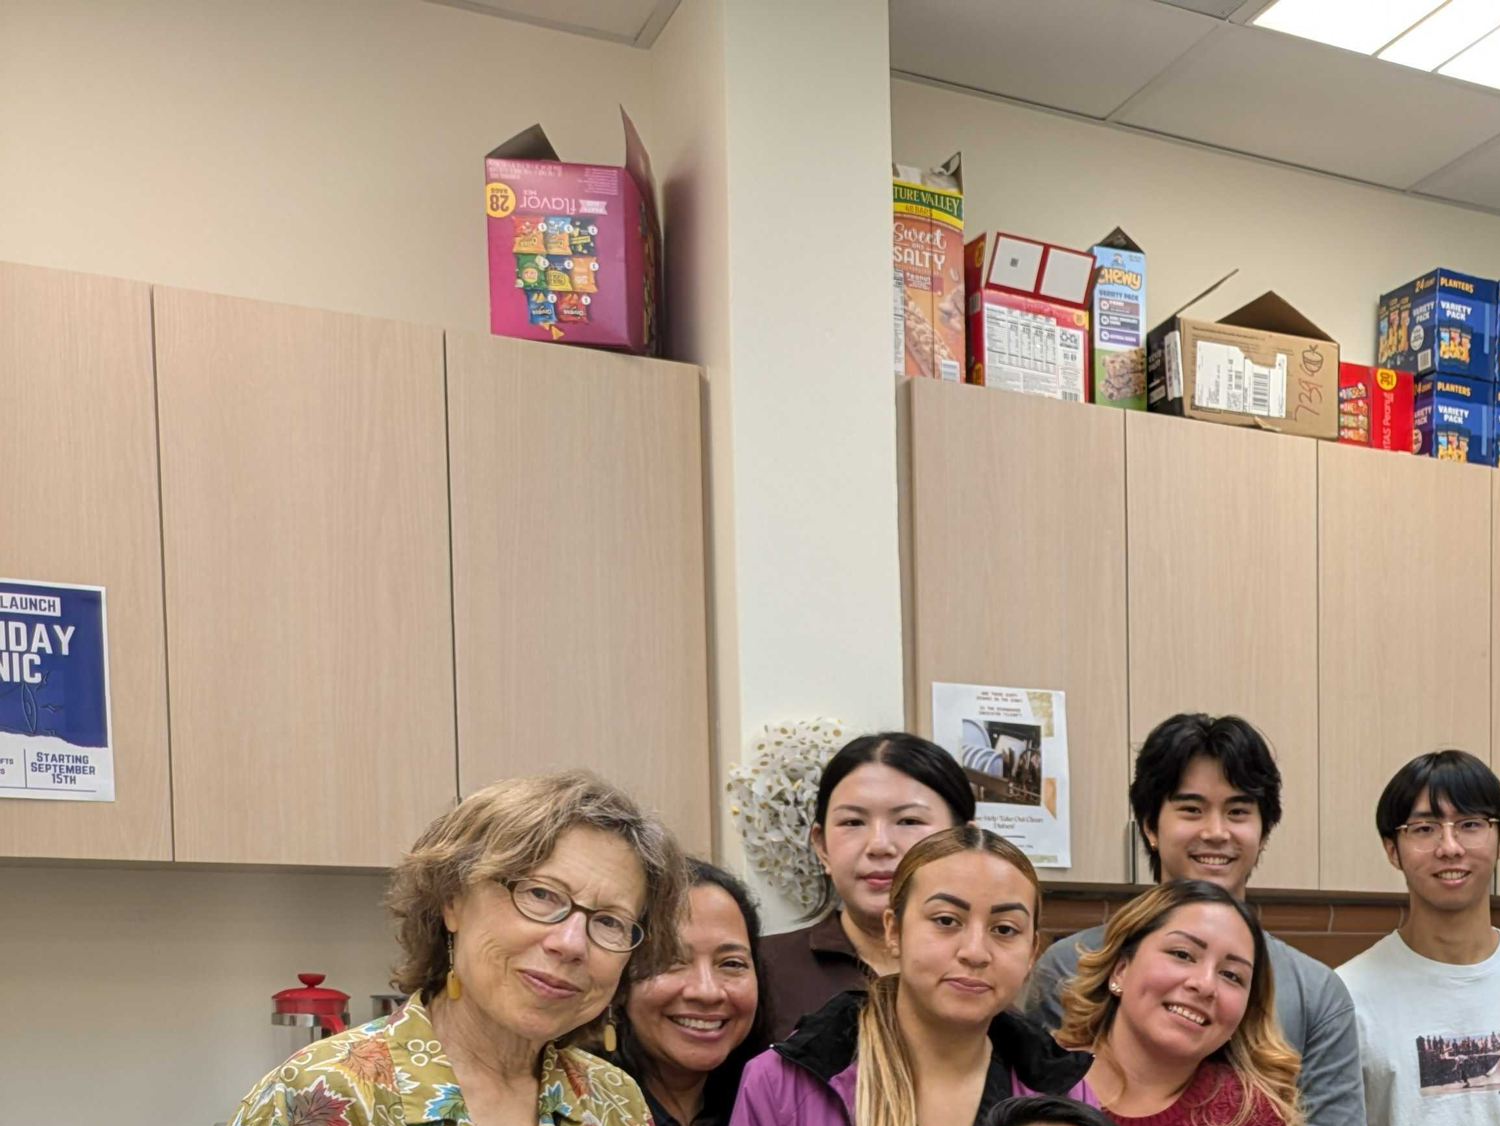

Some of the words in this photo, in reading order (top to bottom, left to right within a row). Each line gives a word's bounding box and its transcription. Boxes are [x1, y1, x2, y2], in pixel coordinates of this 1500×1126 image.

[490, 195, 509, 212] 28
[520, 196, 576, 215] flavor
[893, 186, 919, 202] TURE
[921, 191, 960, 216] VALLEY
[893, 222, 946, 250] Sweet
[893, 246, 945, 271] SALTY
[1440, 277, 1474, 293] PLANTERS
[1440, 301, 1472, 315] VARIETY
[1446, 310, 1466, 321] PACK
[1380, 372, 1390, 386] 30
[1437, 381, 1471, 397] PLANTERS
[1438, 405, 1469, 419] VARIETY
[1444, 413, 1463, 424] PACK
[0, 596, 56, 613] LAUNCH
[36, 752, 89, 764] STARTING
[31, 762, 96, 775] SEPTEMBER
[52, 774, 76, 785] 15TH
